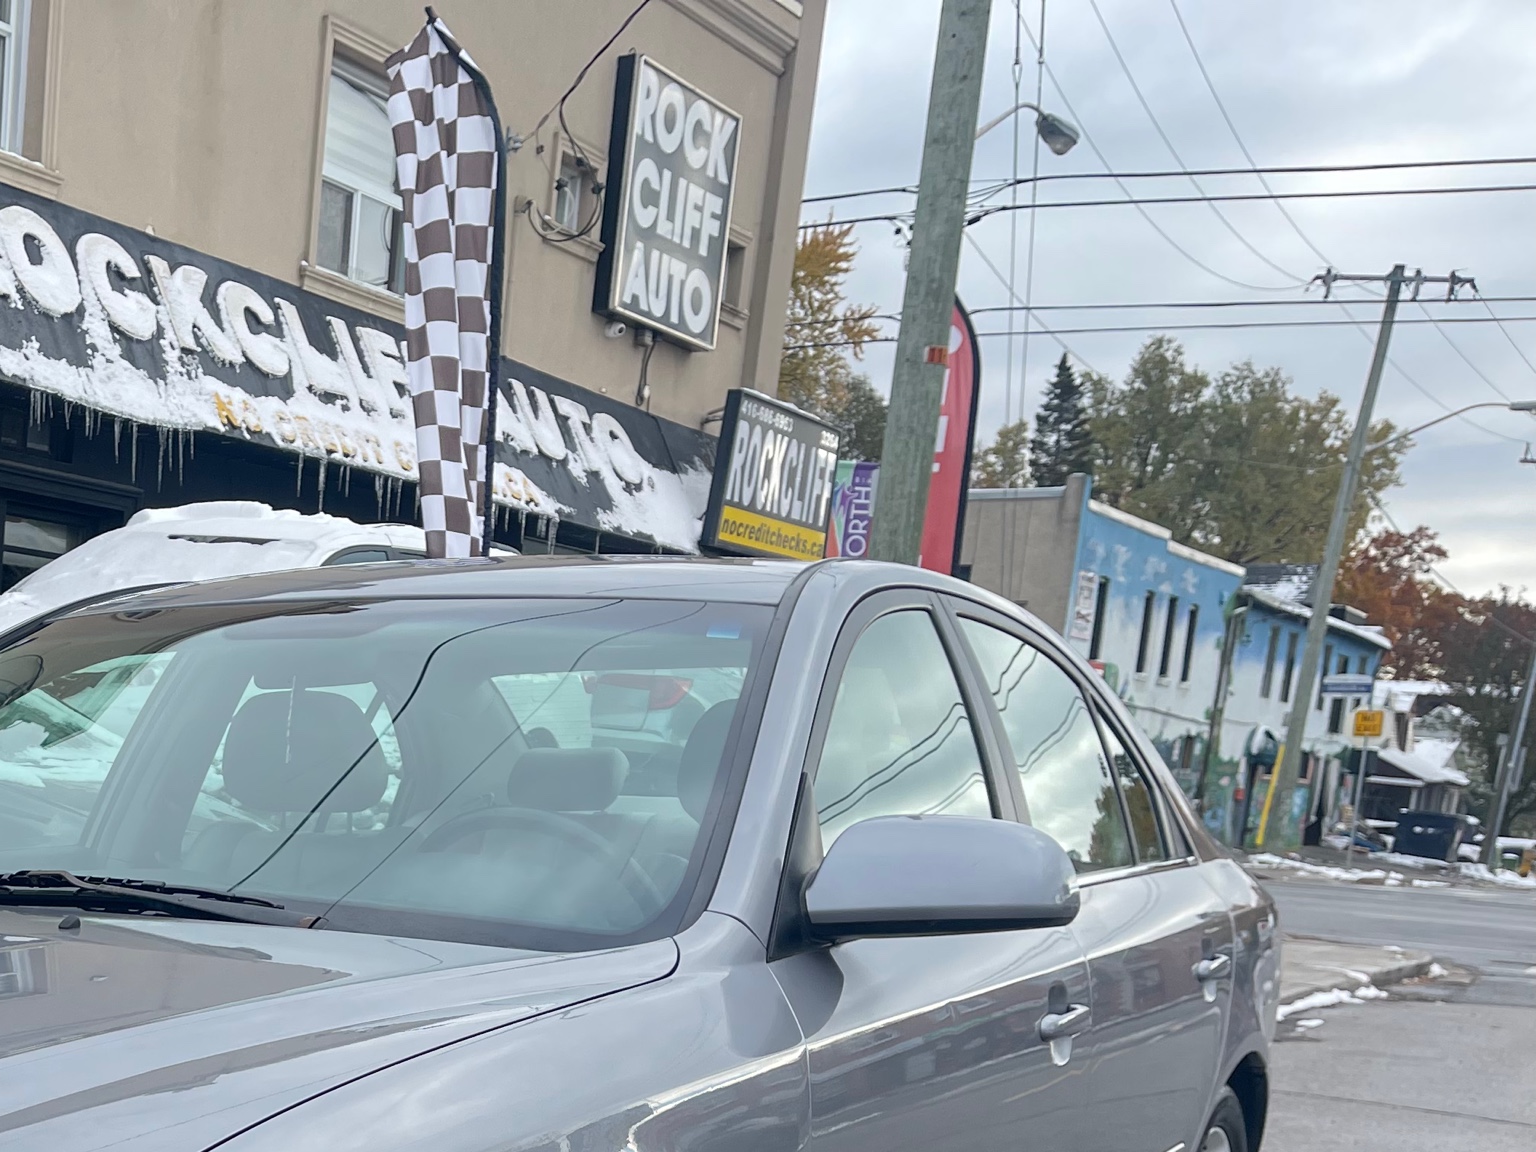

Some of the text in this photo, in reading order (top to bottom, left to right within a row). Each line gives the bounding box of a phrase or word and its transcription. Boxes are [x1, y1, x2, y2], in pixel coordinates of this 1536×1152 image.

[636, 66, 737, 186] ROCK
[632, 157, 724, 257] CLIFF
[622, 241, 712, 334] AUTO
[725, 419, 837, 527] ROCKCLIFF
[721, 517, 825, 557] nocreditchecks.ca
